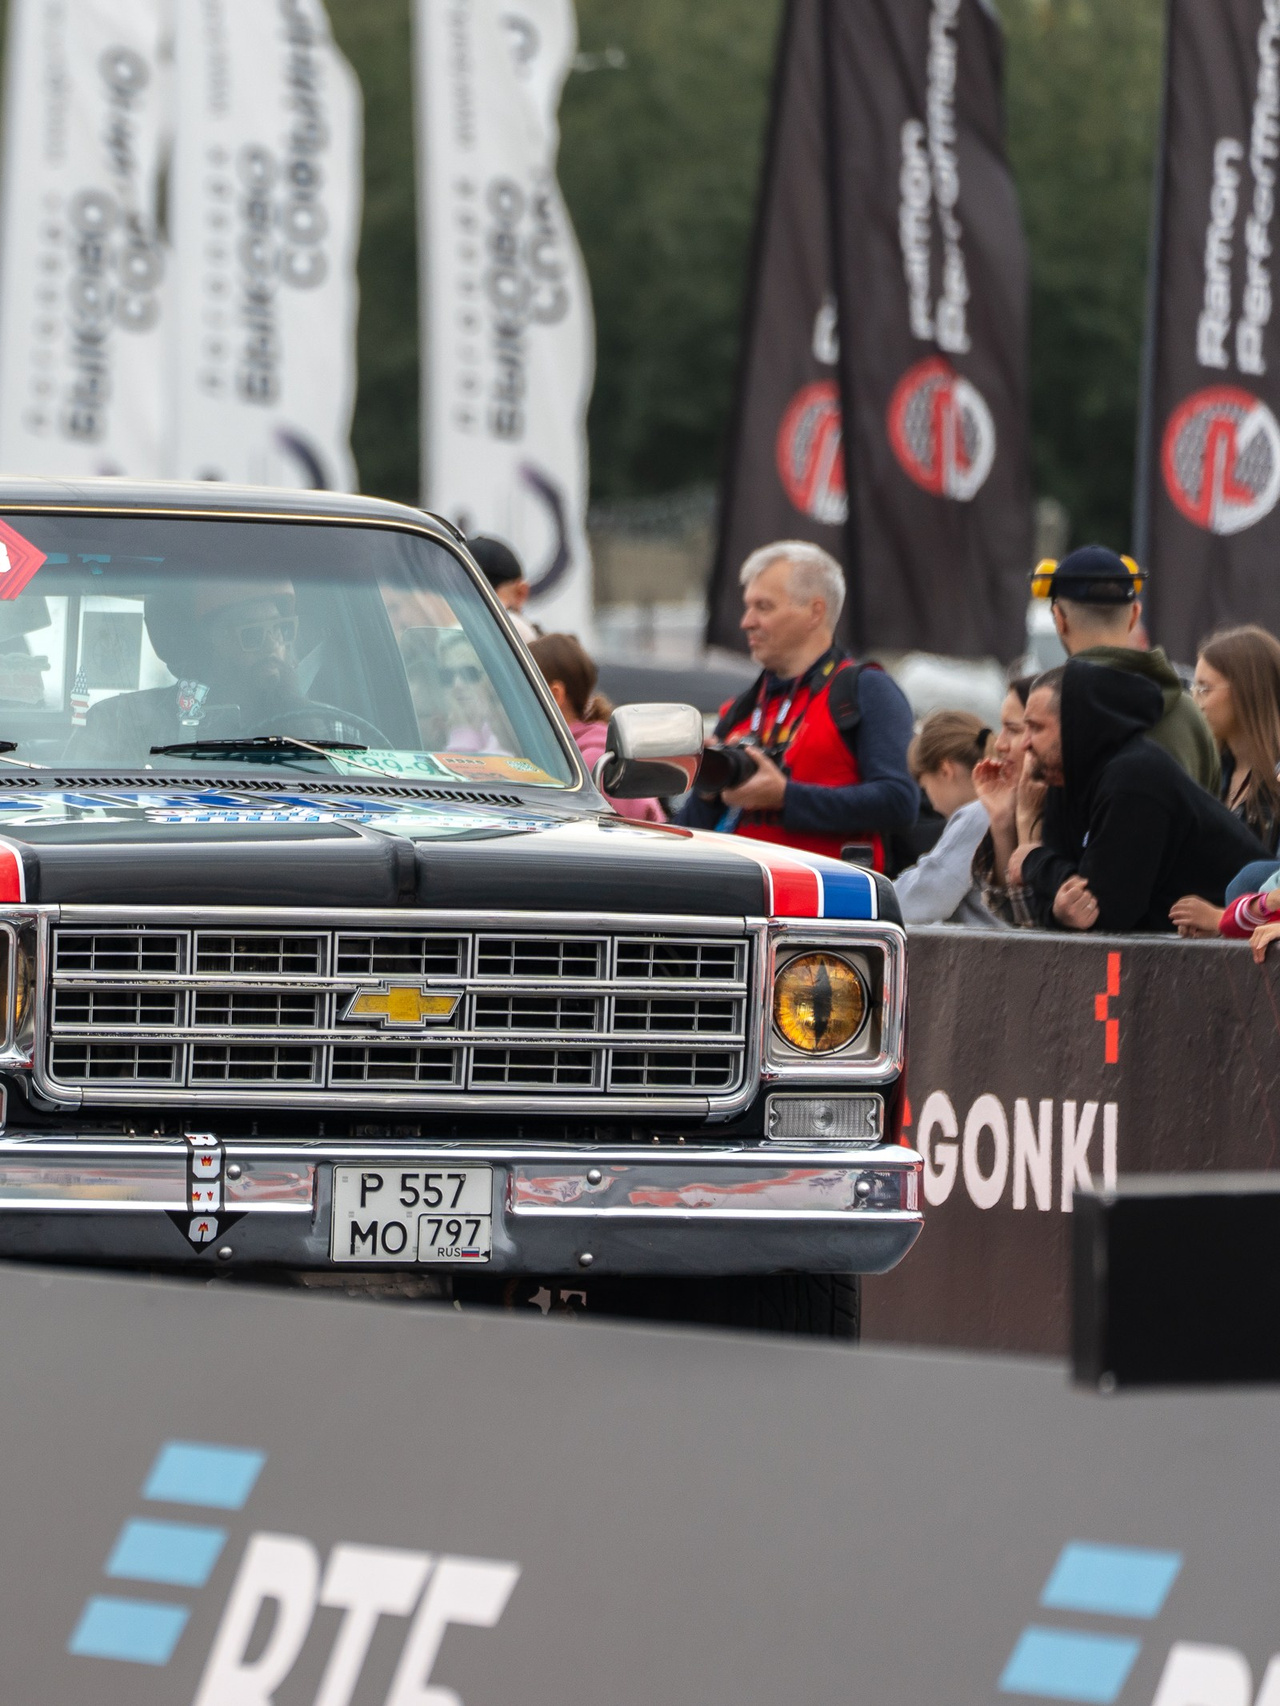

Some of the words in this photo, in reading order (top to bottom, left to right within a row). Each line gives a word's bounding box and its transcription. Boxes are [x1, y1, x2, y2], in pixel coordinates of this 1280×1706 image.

[399, 1172, 466, 1209] 557
[426, 1218, 482, 1247] 797
[437, 1247, 461, 1258] RUS
